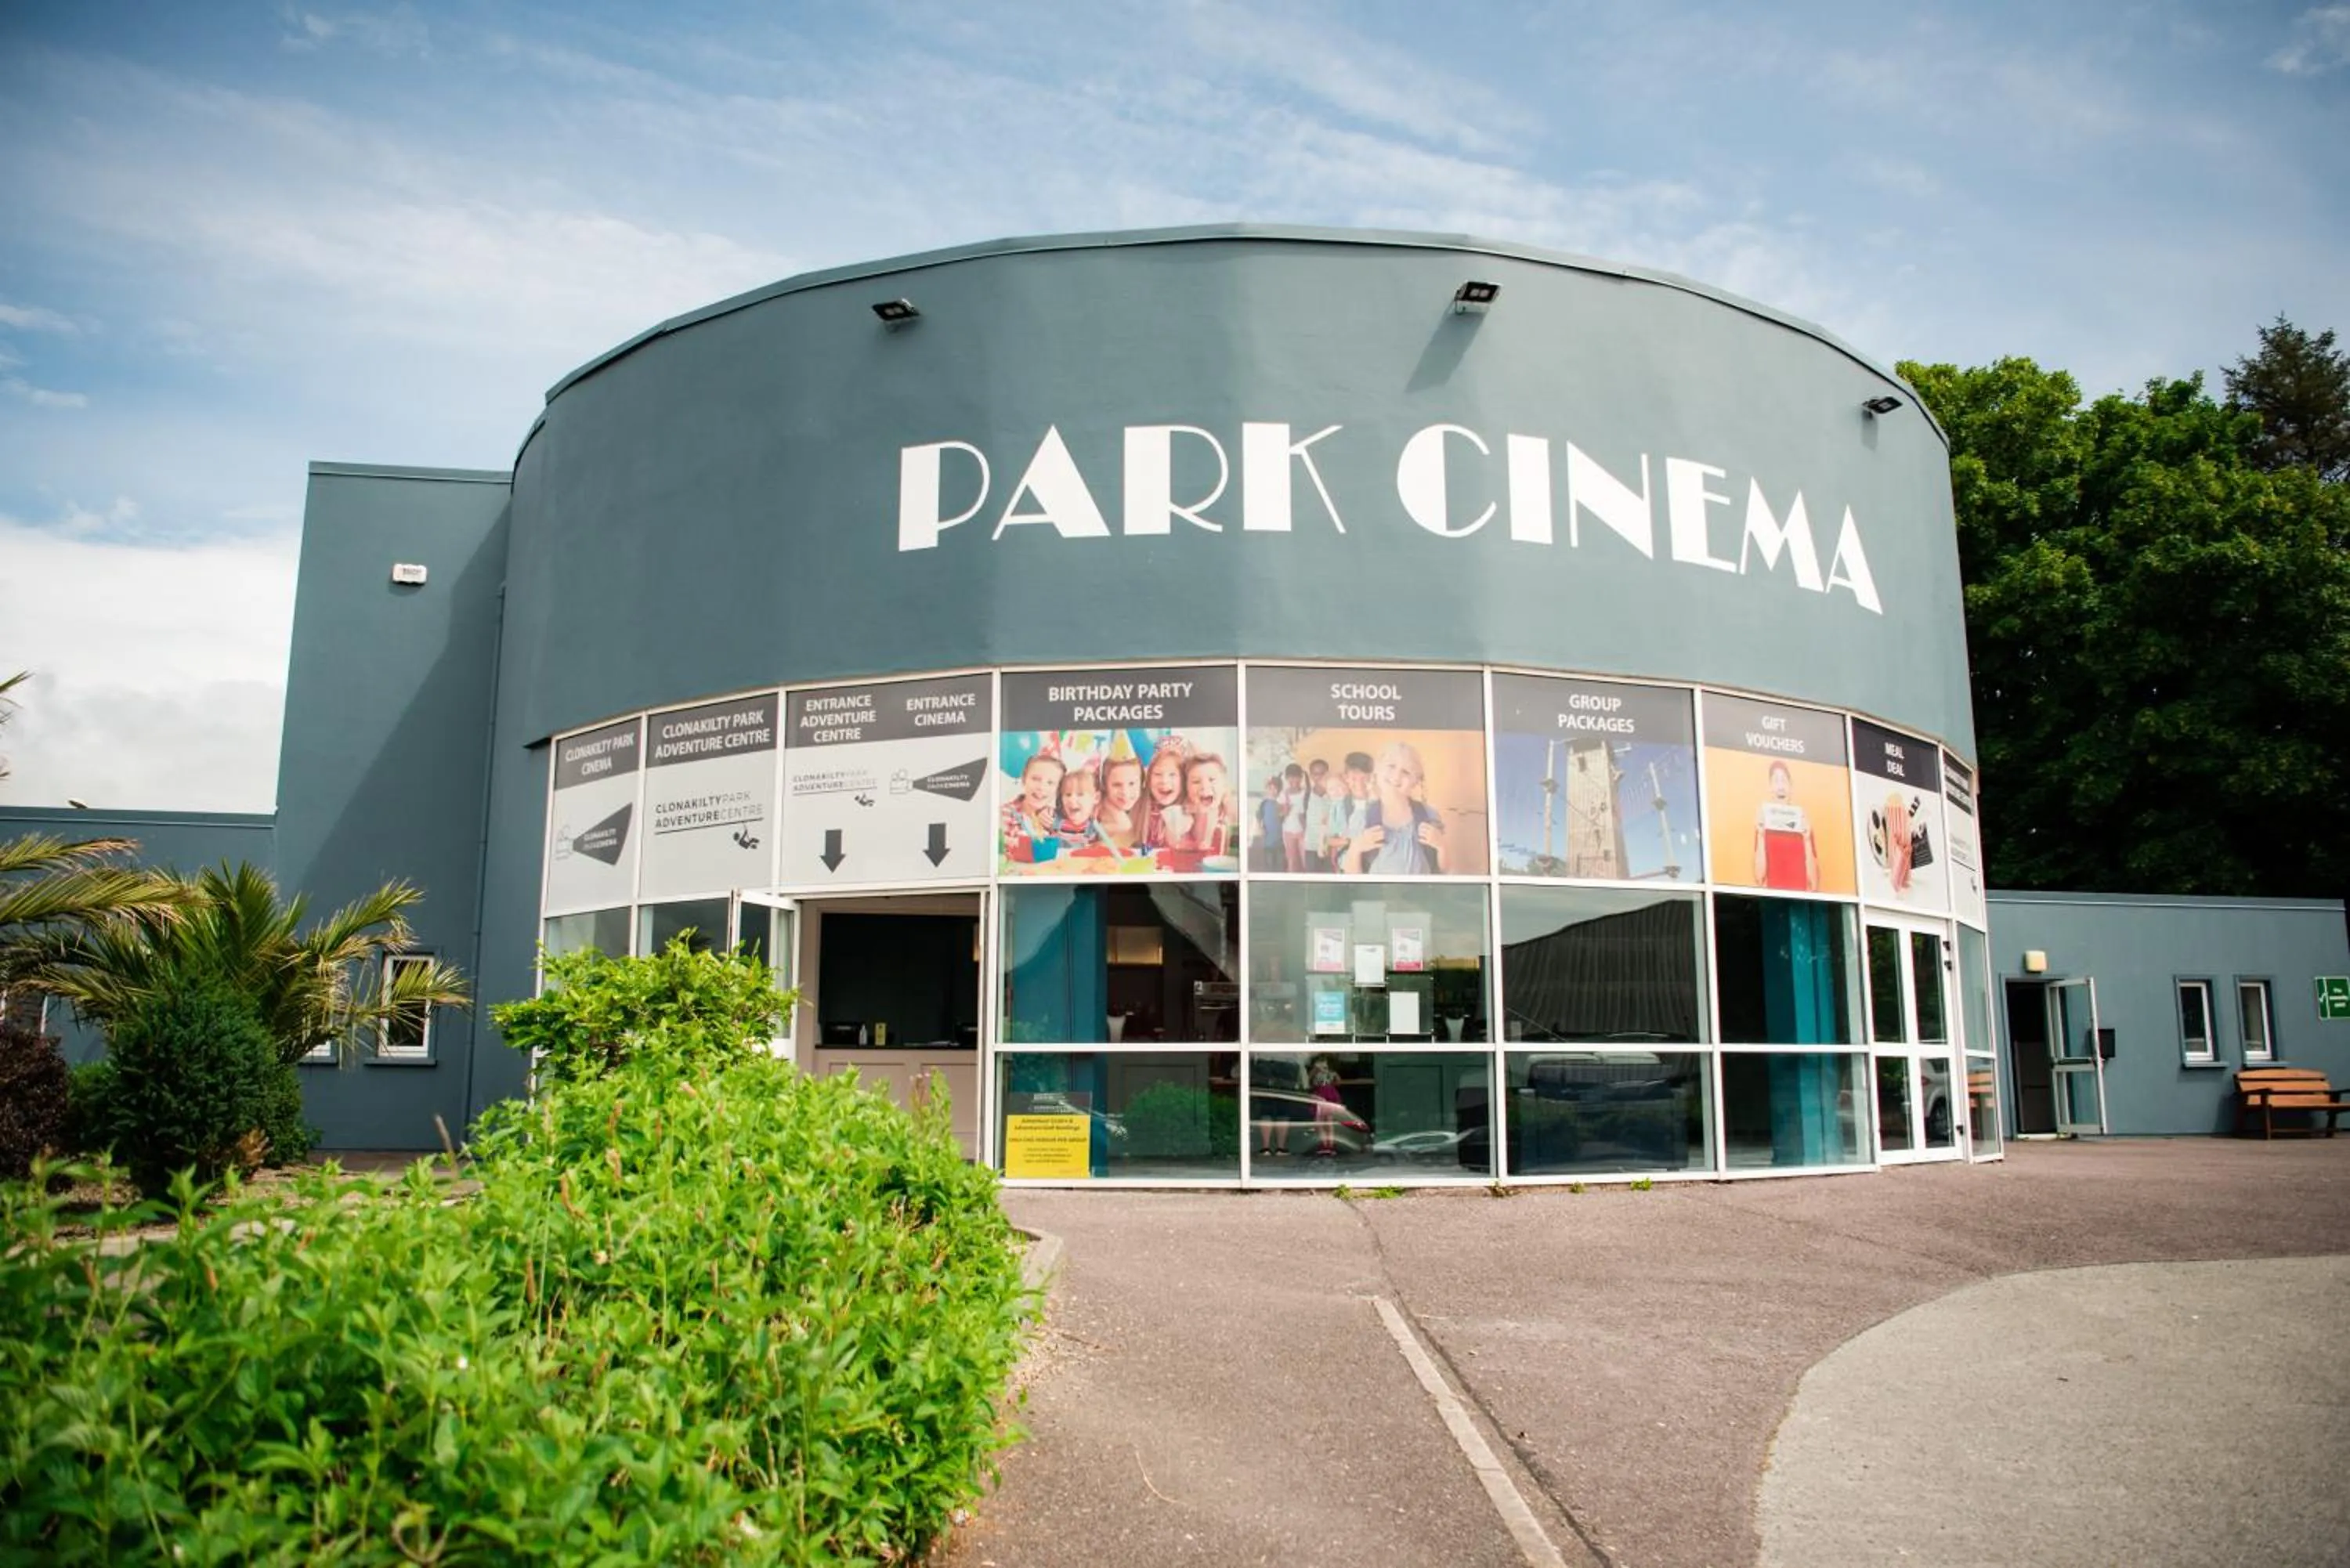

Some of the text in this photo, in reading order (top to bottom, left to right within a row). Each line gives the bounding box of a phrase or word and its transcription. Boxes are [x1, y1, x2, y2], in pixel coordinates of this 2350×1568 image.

[898, 422, 1883, 616] PARK CINEMA
[1048, 682, 1193, 703] BIRTHDAY PARTY
[1330, 683, 1402, 700] SCHOOL
[805, 695, 873, 712] ENTRANCE
[906, 693, 976, 711] ENTRANCE
[1569, 694, 1622, 712] GROUP
[801, 710, 877, 728] ADVENTURE
[914, 710, 966, 727] CINEMA
[1074, 704, 1163, 722] PACKAGES
[1337, 704, 1395, 721] TOURS
[662, 710, 765, 739] CLONAKILTY PARK
[1558, 714, 1635, 733] PACKAGES
[1762, 715, 1786, 732] GIFT
[655, 728, 771, 758] ADVENTURE CENTRE
[814, 728, 861, 742] CENTRE
[1745, 732, 1805, 753] VOUCHERS
[566, 732, 635, 761] CLONAKILTY PARK
[1885, 742, 1905, 760] MEAL
[581, 757, 613, 775] CINEMA
[1886, 761, 1906, 778] DEAL
